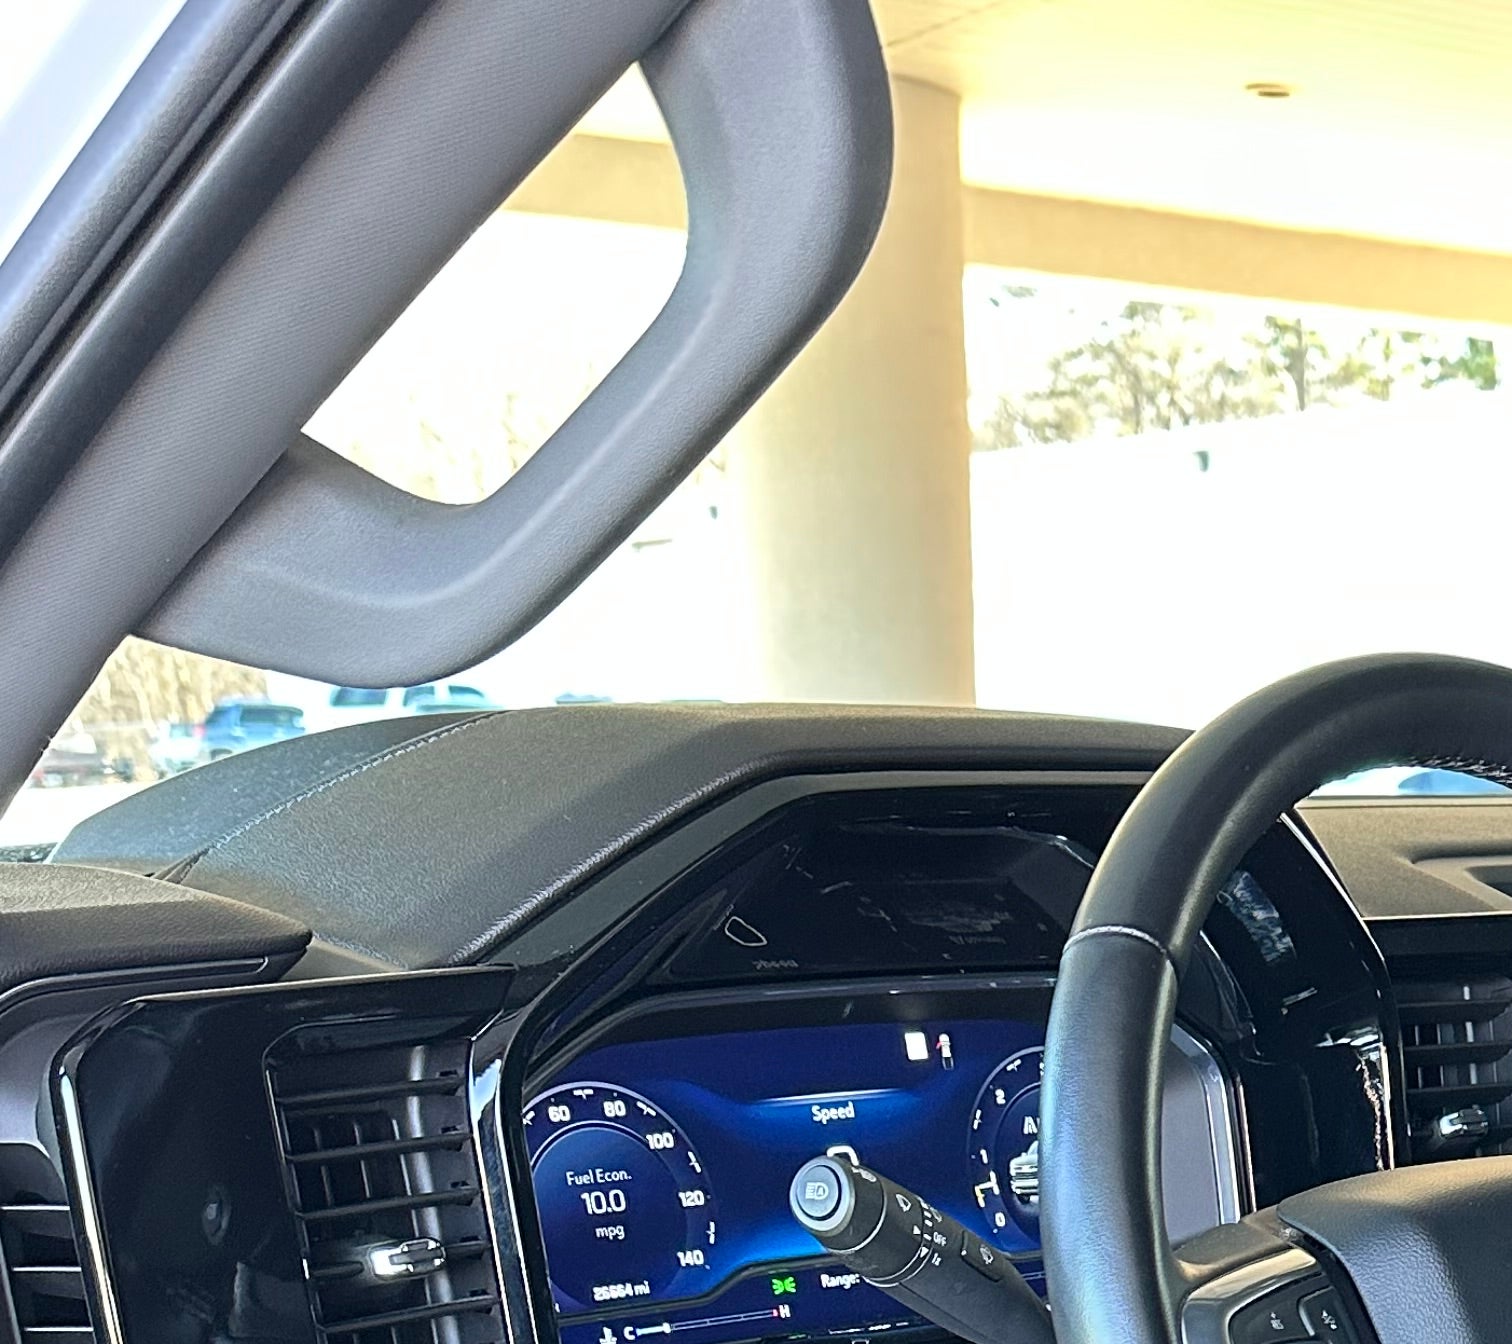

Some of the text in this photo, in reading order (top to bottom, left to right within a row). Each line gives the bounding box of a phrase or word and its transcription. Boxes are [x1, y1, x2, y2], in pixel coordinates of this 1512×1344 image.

[994, 1088, 1006, 1105] 2
[548, 1105, 571, 1123] 60
[603, 1100, 627, 1117] 80
[811, 1100, 855, 1125] Speed
[646, 1132, 675, 1150] 100
[566, 1168, 633, 1186] Fuel Econ.
[580, 1189, 627, 1215] 10.0
[678, 1190, 705, 1207] 120
[994, 1211, 1006, 1228] 0
[595, 1226, 625, 1241] mpg
[933, 1231, 947, 1247] OFF
[676, 1249, 704, 1268] 140
[634, 1280, 651, 1296] mi
[820, 1273, 861, 1290] Range:
[778, 1304, 791, 1319] H
[623, 1326, 637, 1341] C
